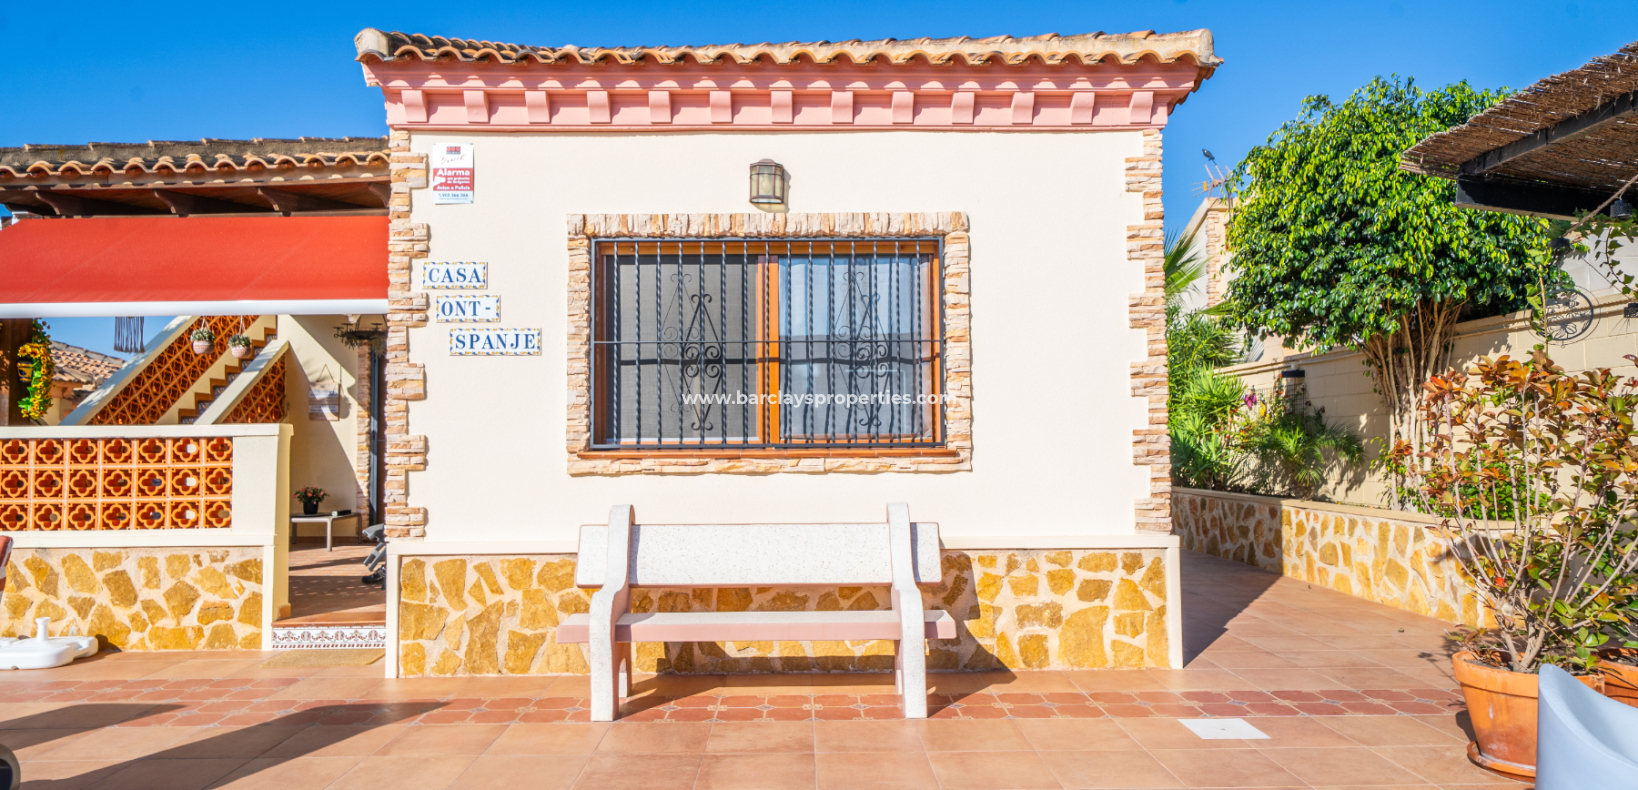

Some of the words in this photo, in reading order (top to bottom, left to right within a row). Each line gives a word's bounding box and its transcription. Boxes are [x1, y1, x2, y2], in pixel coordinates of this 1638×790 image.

[437, 168, 470, 176] Alarma
[428, 267, 482, 283] CASA
[455, 333, 536, 350] SPANJE
